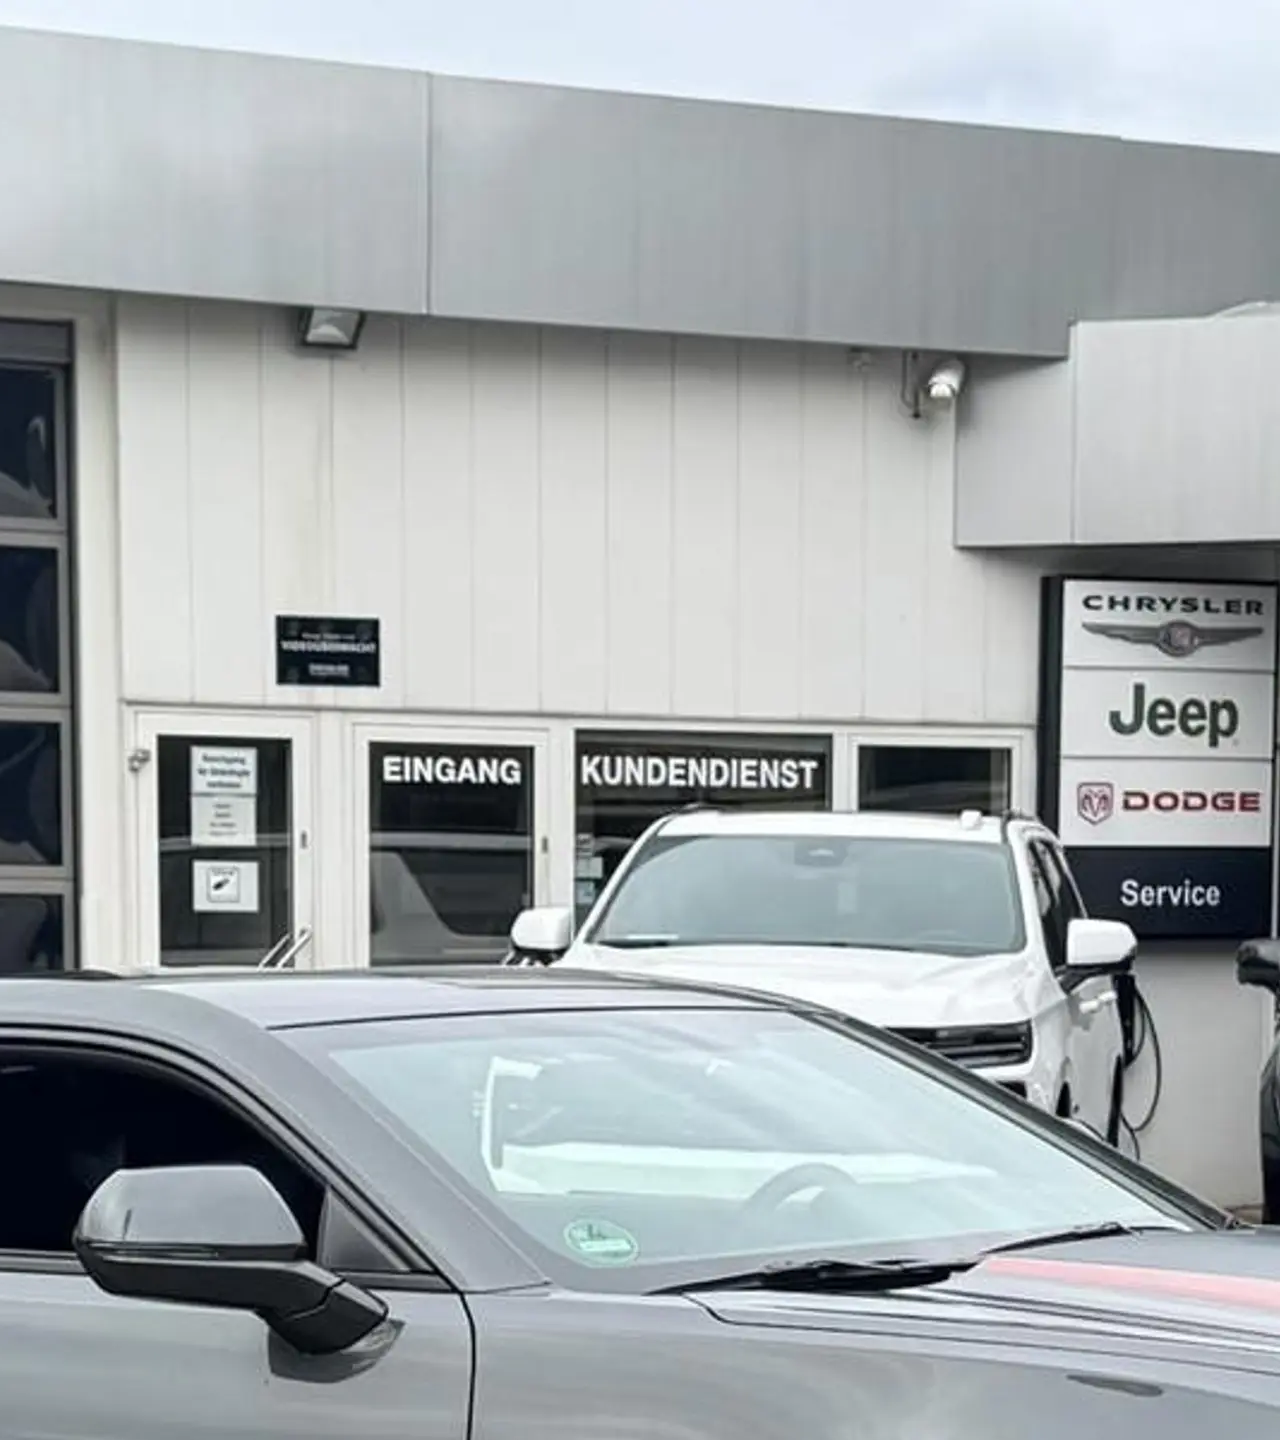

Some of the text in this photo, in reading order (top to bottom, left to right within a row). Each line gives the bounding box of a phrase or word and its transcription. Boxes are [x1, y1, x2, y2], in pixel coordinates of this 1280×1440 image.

[1081, 594, 1264, 616] CHRYSLER
[1109, 683, 1239, 748] Jeep
[381, 754, 523, 786] EINGANG
[580, 754, 819, 790] KUNDENDIENST
[1123, 791, 1261, 812] DODGE
[1119, 877, 1221, 908] Service
